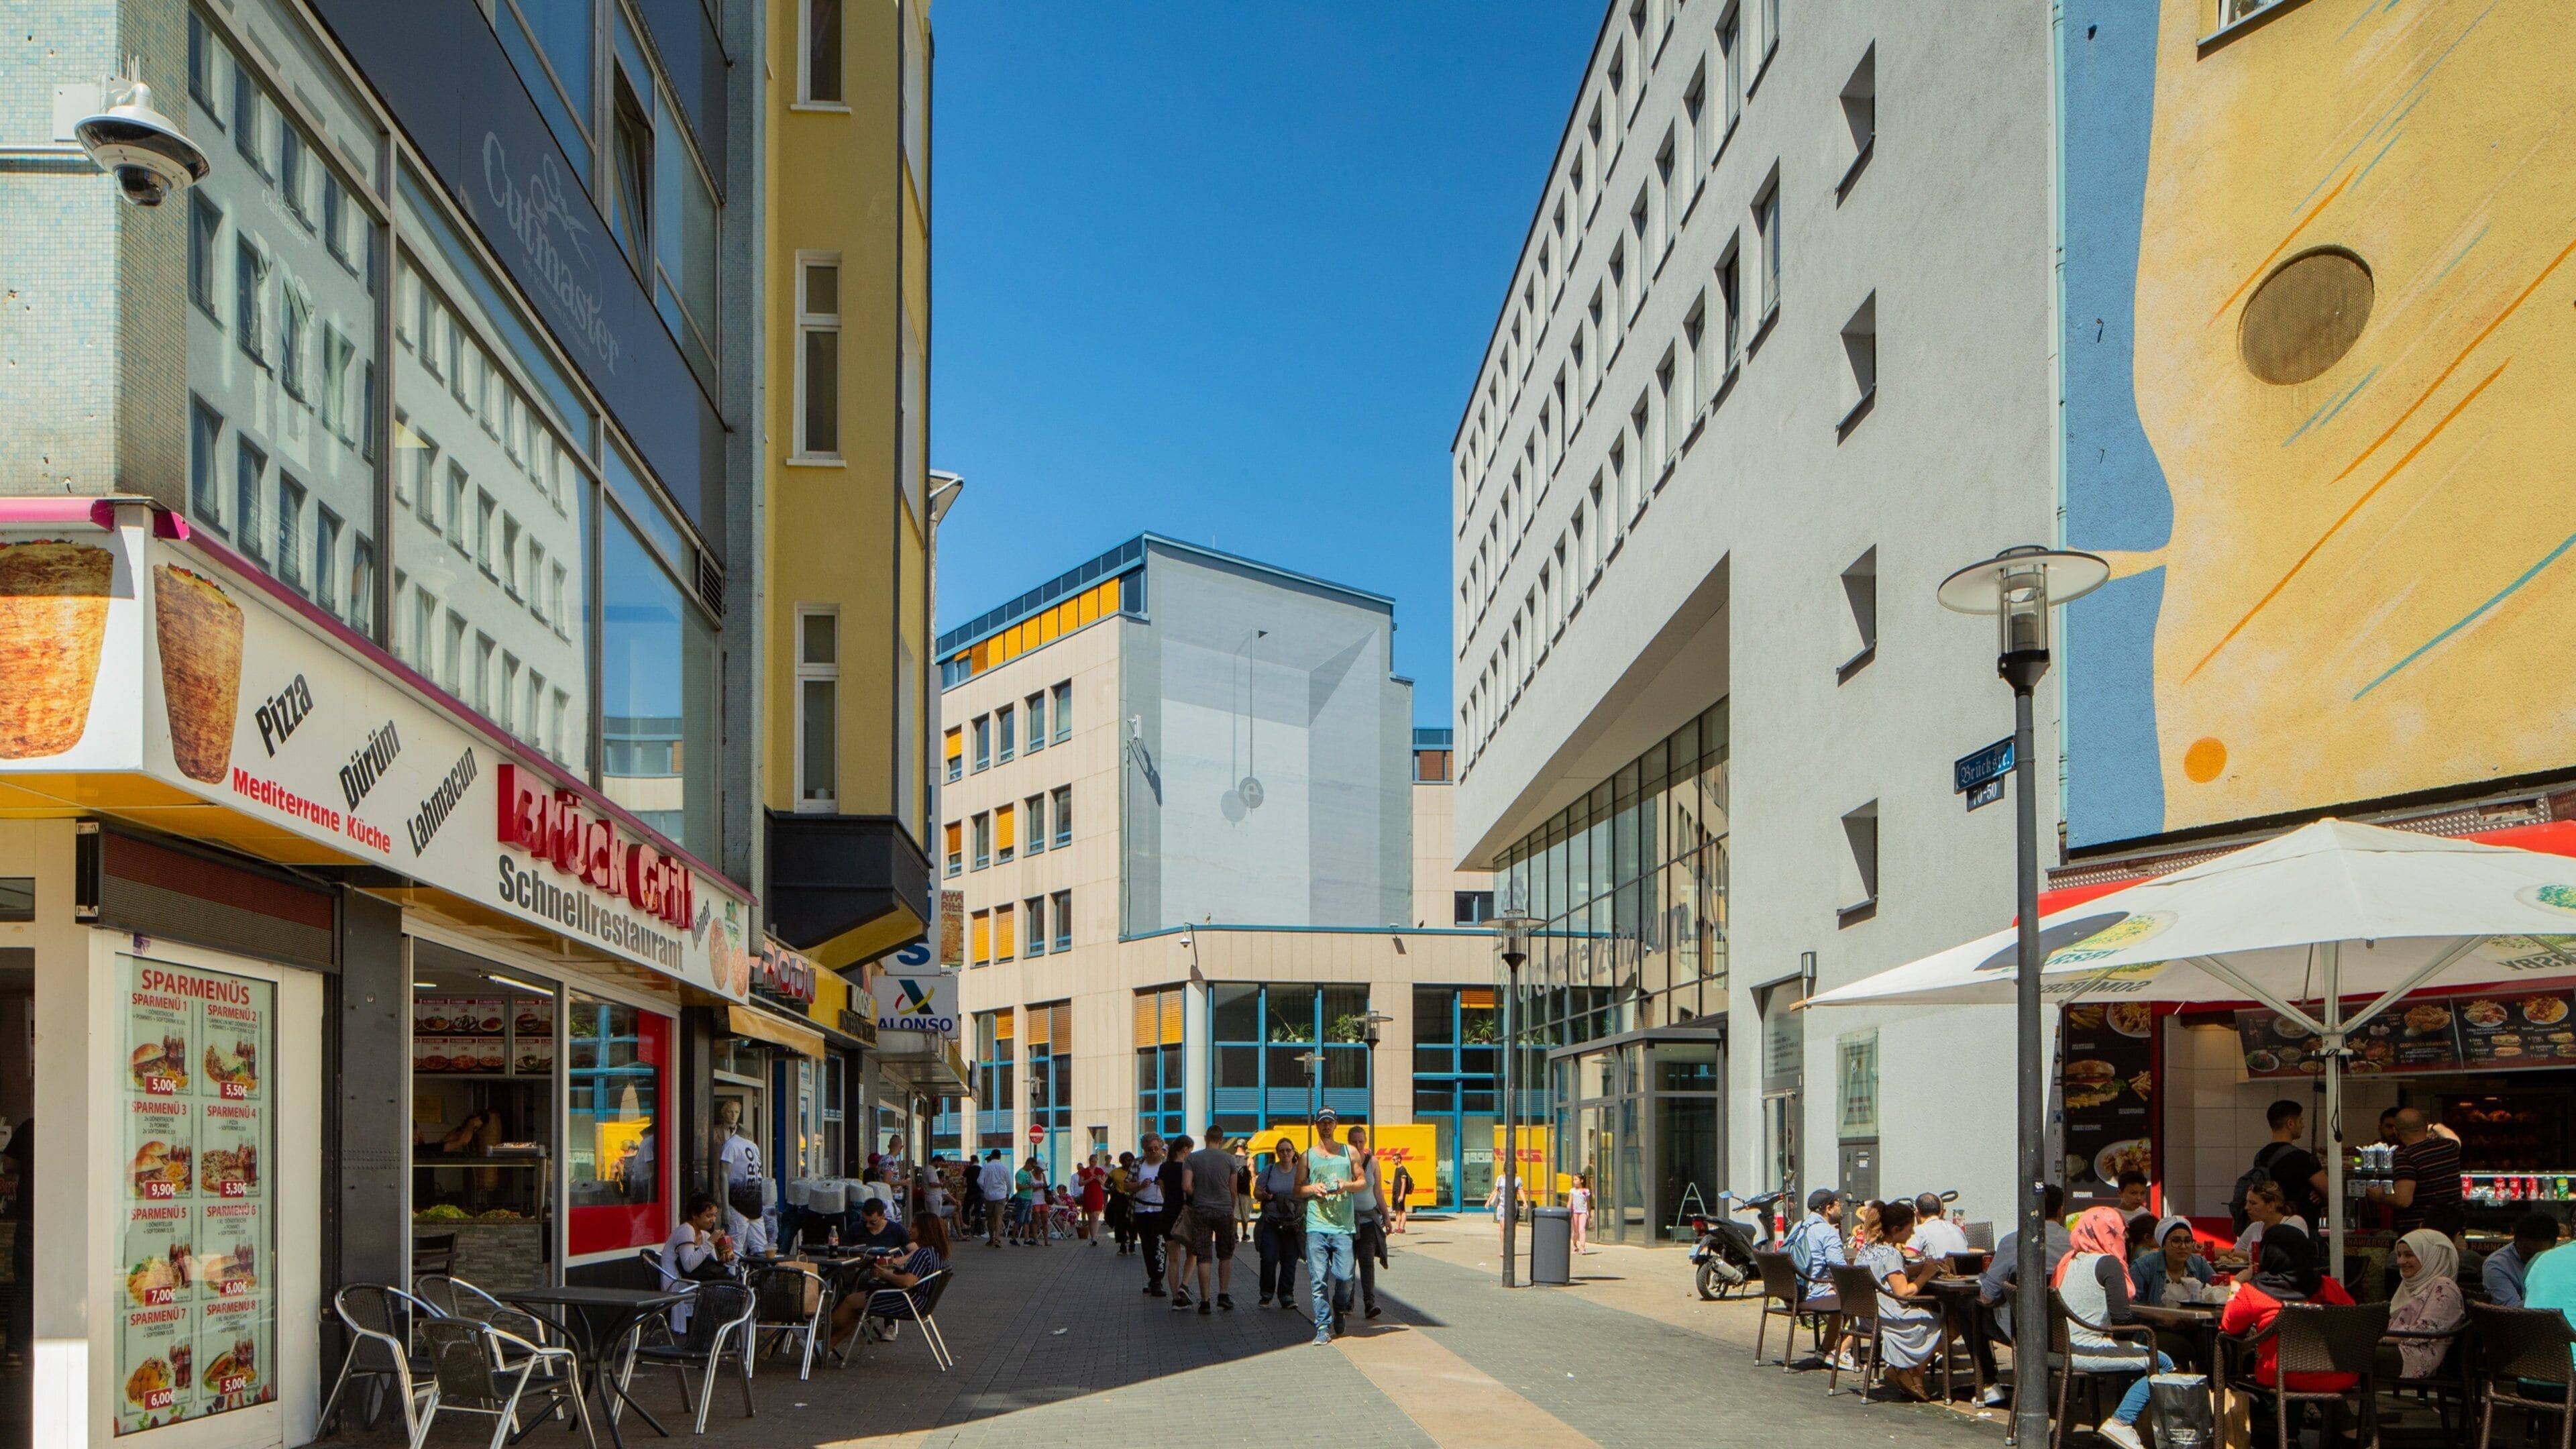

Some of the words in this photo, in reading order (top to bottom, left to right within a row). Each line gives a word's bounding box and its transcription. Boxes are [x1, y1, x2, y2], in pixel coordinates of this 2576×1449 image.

[483, 131, 619, 375] Cutmaster
[254, 674, 314, 758] Pizza
[338, 719, 401, 812] Dürüm
[232, 767, 340, 833] Mediterrane
[346, 814, 391, 854] Küche
[406, 746, 478, 858] Lahmacun
[498, 855, 684, 973] Schnellrestaurant
[142, 969, 250, 1005] SPARMENÜS
[131, 992, 180, 1011] SPARMENÜ
[183, 1000, 187, 1012] 1
[851, 983, 872, 1019] KIOSK
[208, 1004, 250, 1021] SPARMENÜ
[252, 1011, 256, 1022] 2
[877, 1017, 953, 1032] ALONSO
[152, 1078, 177, 1092] 5,00€
[227, 1084, 248, 1097] 5,50€
[131, 1101, 180, 1115] SPARMENÜ
[182, 1106, 186, 1116] 3
[207, 1106, 250, 1118] SPARMENÜ
[252, 1109, 256, 1119] 4
[745, 1146, 755, 1189] BRO
[152, 1183, 176, 1198] 9,90€
[225, 1182, 247, 1195] 5,30€
[131, 1204, 179, 1221] SPARMENÜ
[182, 1208, 186, 1218] 5
[207, 1202, 250, 1218] SPARMENÜ
[152, 1289, 176, 1303] 7,00€
[225, 1282, 248, 1295] 6,00€
[207, 1298, 250, 1316] SPARMENÜ
[131, 1307, 179, 1326] SPARMENÜ
[182, 1308, 186, 1320] 7
[225, 1375, 247, 1393] 5,00€
[151, 1390, 176, 1409] 6,00€
